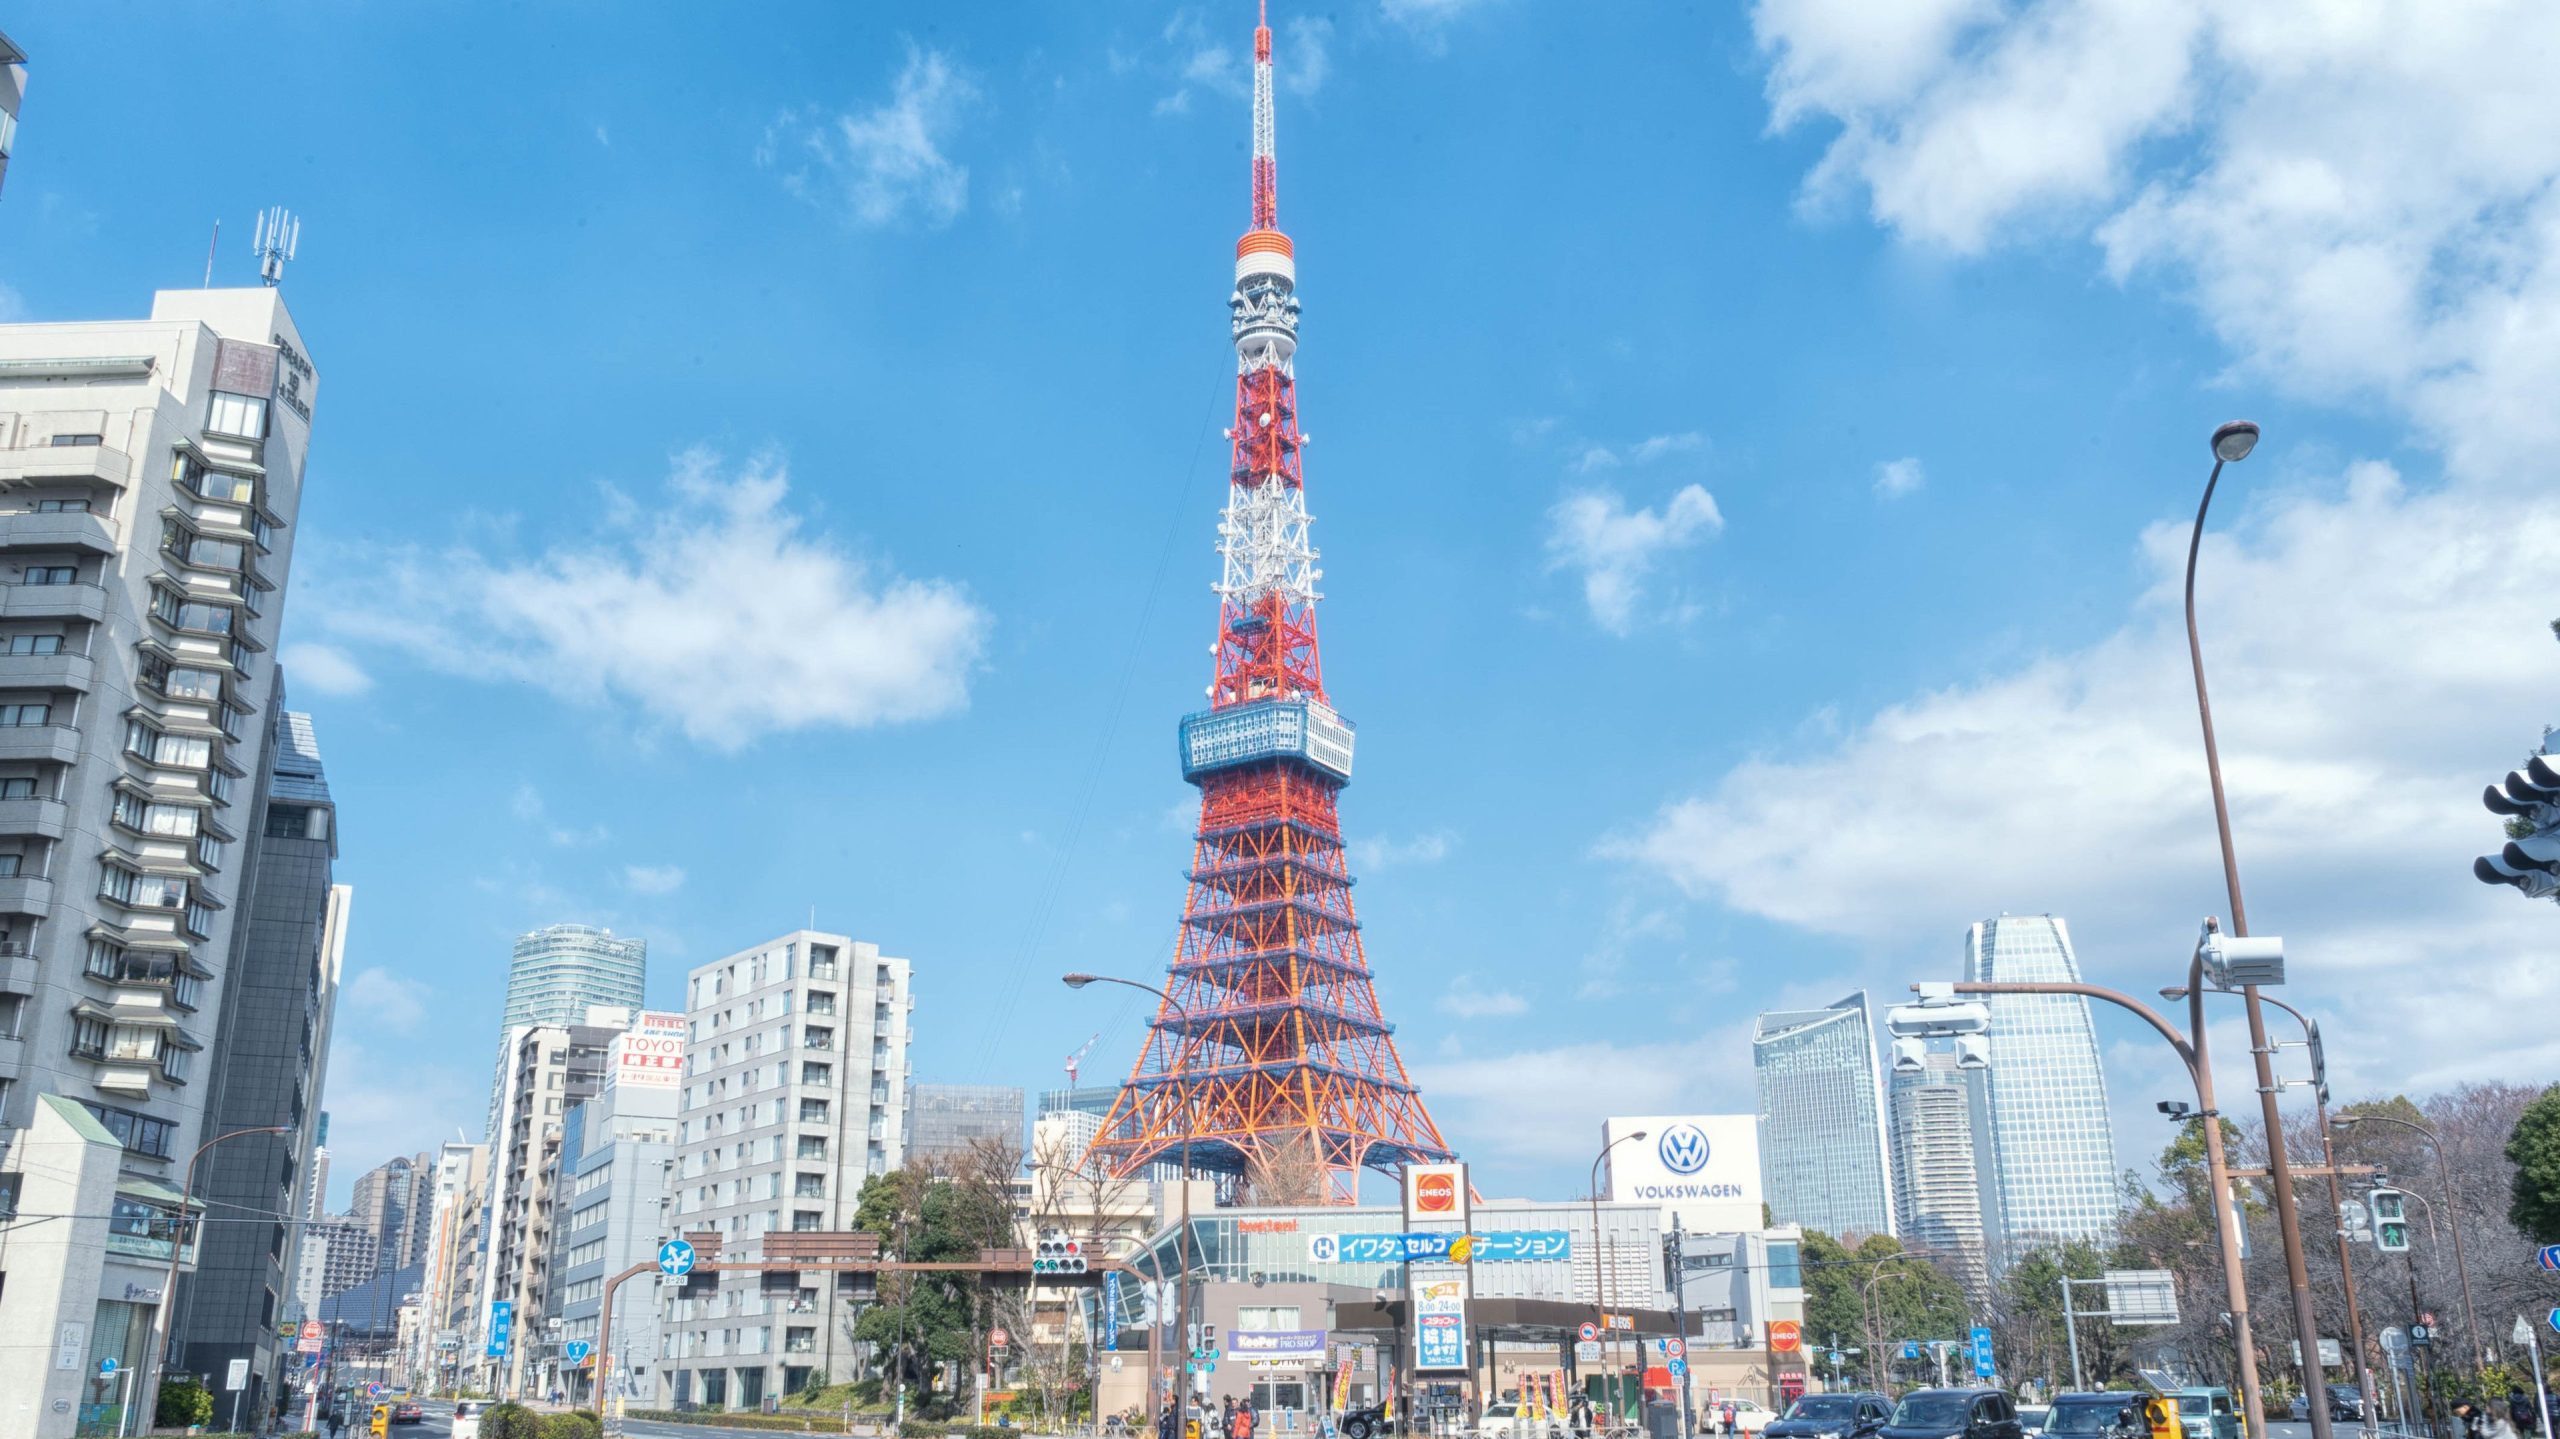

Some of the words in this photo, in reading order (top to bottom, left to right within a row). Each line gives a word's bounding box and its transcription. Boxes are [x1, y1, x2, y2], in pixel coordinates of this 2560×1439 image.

[1419, 1187, 1452, 1197] ENEOS
[1634, 1184, 1742, 1199] VOLKSWAGEN
[1405, 1237, 1446, 1254] セルフ
[1423, 1327, 1458, 1345] 給油
[1771, 1331, 1797, 1340] ENEOS
[1280, 1340, 1296, 1349] PRO
[1296, 1338, 1317, 1348] SHOP
[574, 1345, 580, 1355] 1
